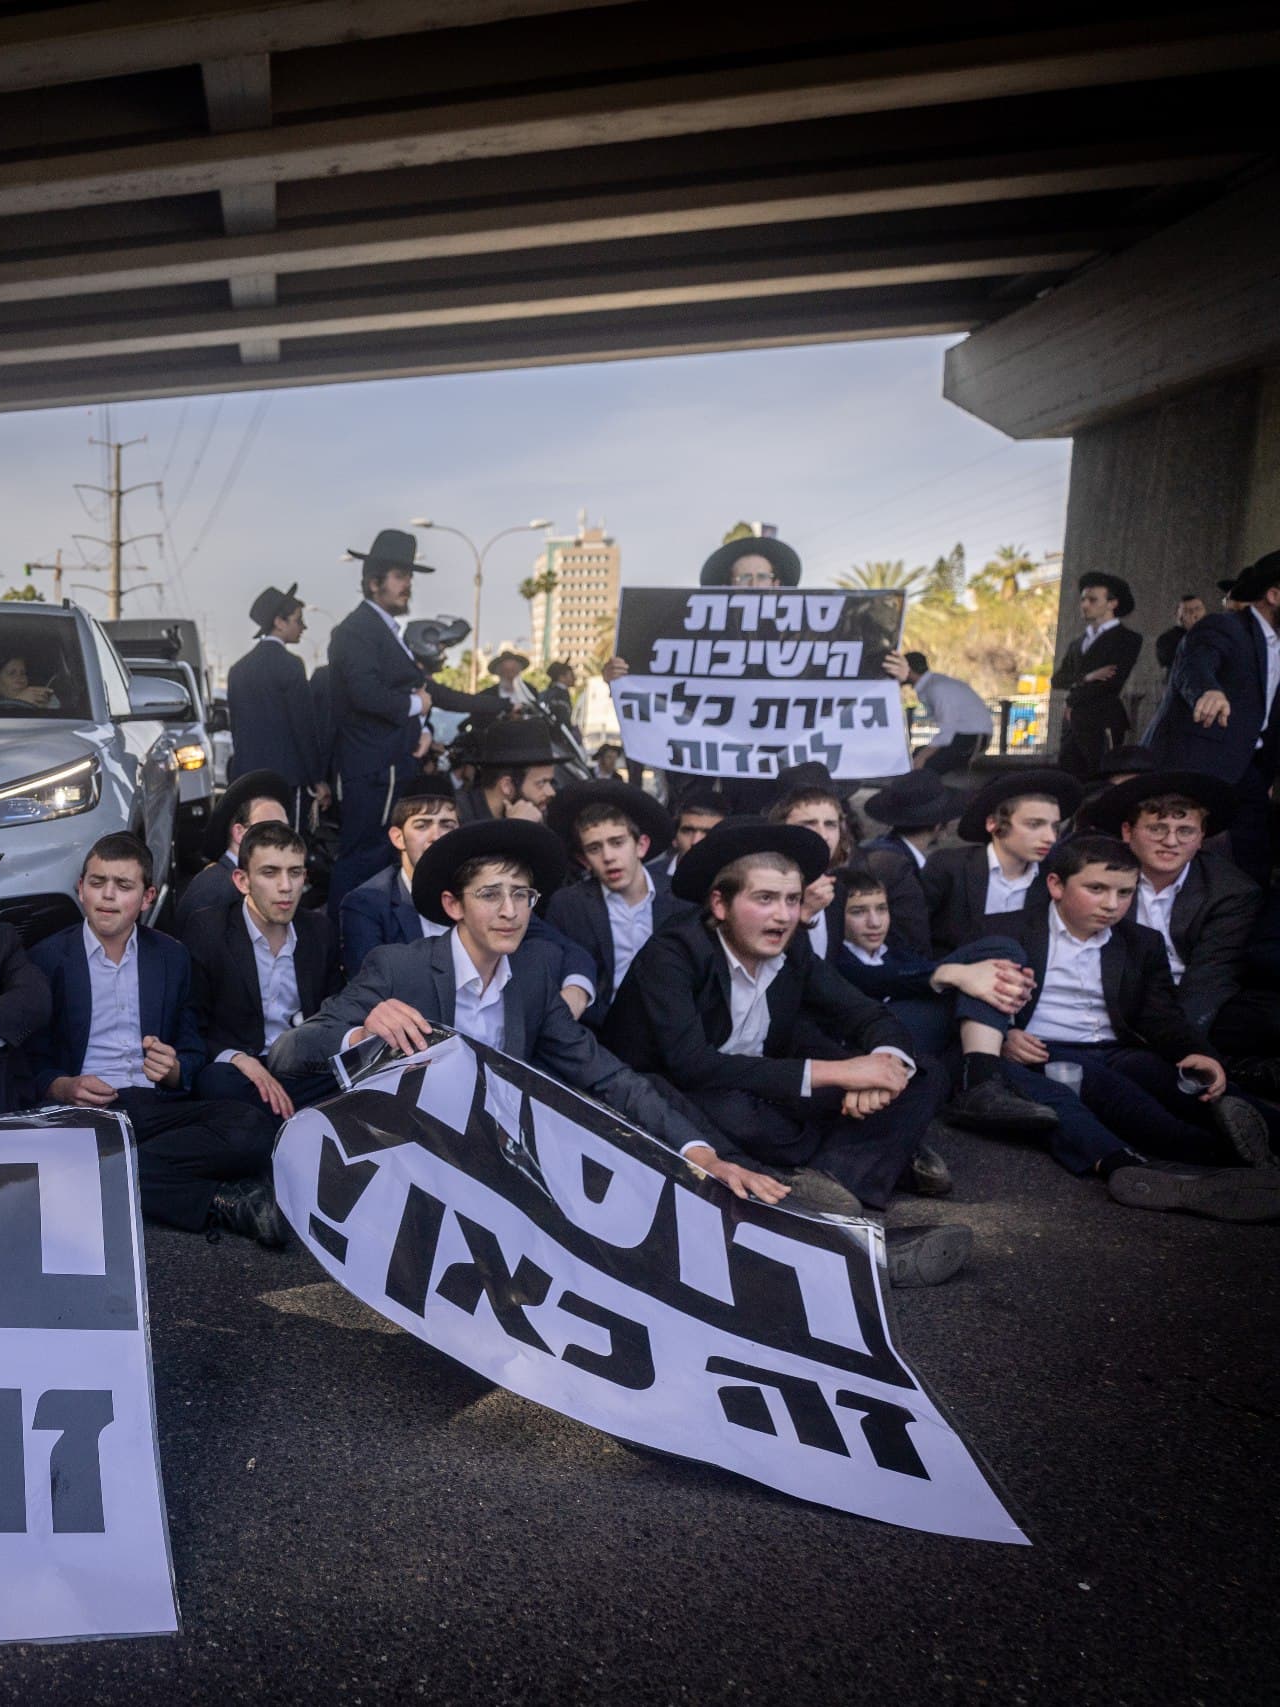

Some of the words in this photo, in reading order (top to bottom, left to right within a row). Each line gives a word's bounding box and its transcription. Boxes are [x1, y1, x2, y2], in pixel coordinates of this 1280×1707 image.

[684, 593, 846, 633] סגירת
[649, 638, 864, 678] הישיבות
[620, 680, 735, 726] כליה
[749, 697, 889, 730] גזירת
[668, 731, 843, 773] ליהדות
[706, 1355, 931, 1480] זה
